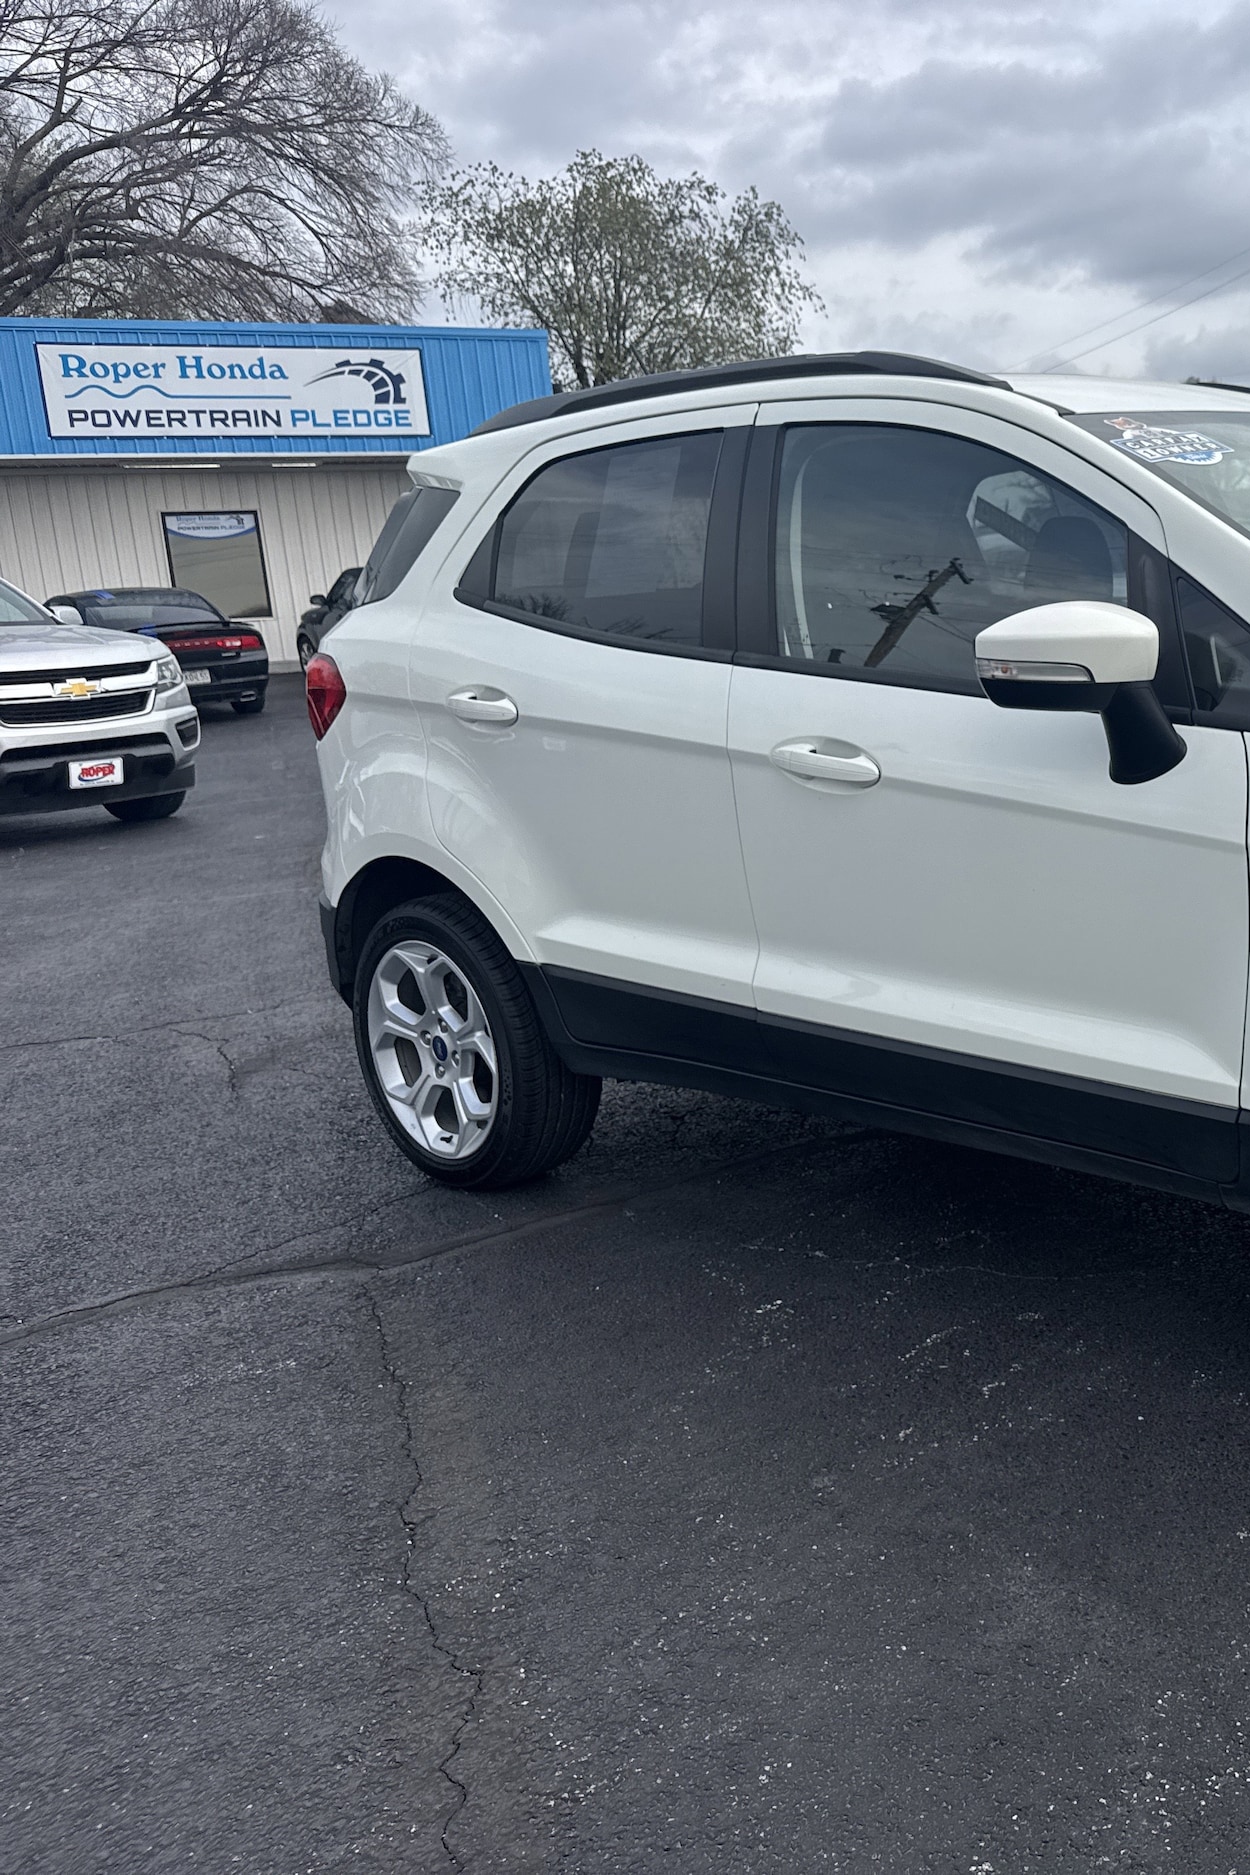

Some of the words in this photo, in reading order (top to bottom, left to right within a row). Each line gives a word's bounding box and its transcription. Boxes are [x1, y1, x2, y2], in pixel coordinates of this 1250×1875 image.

[58, 353, 166, 383] Roper
[176, 355, 289, 380] Honda
[67, 409, 281, 428] POWERTRAIN
[290, 409, 412, 428] PLEDGE
[81, 763, 115, 778] ROPER
